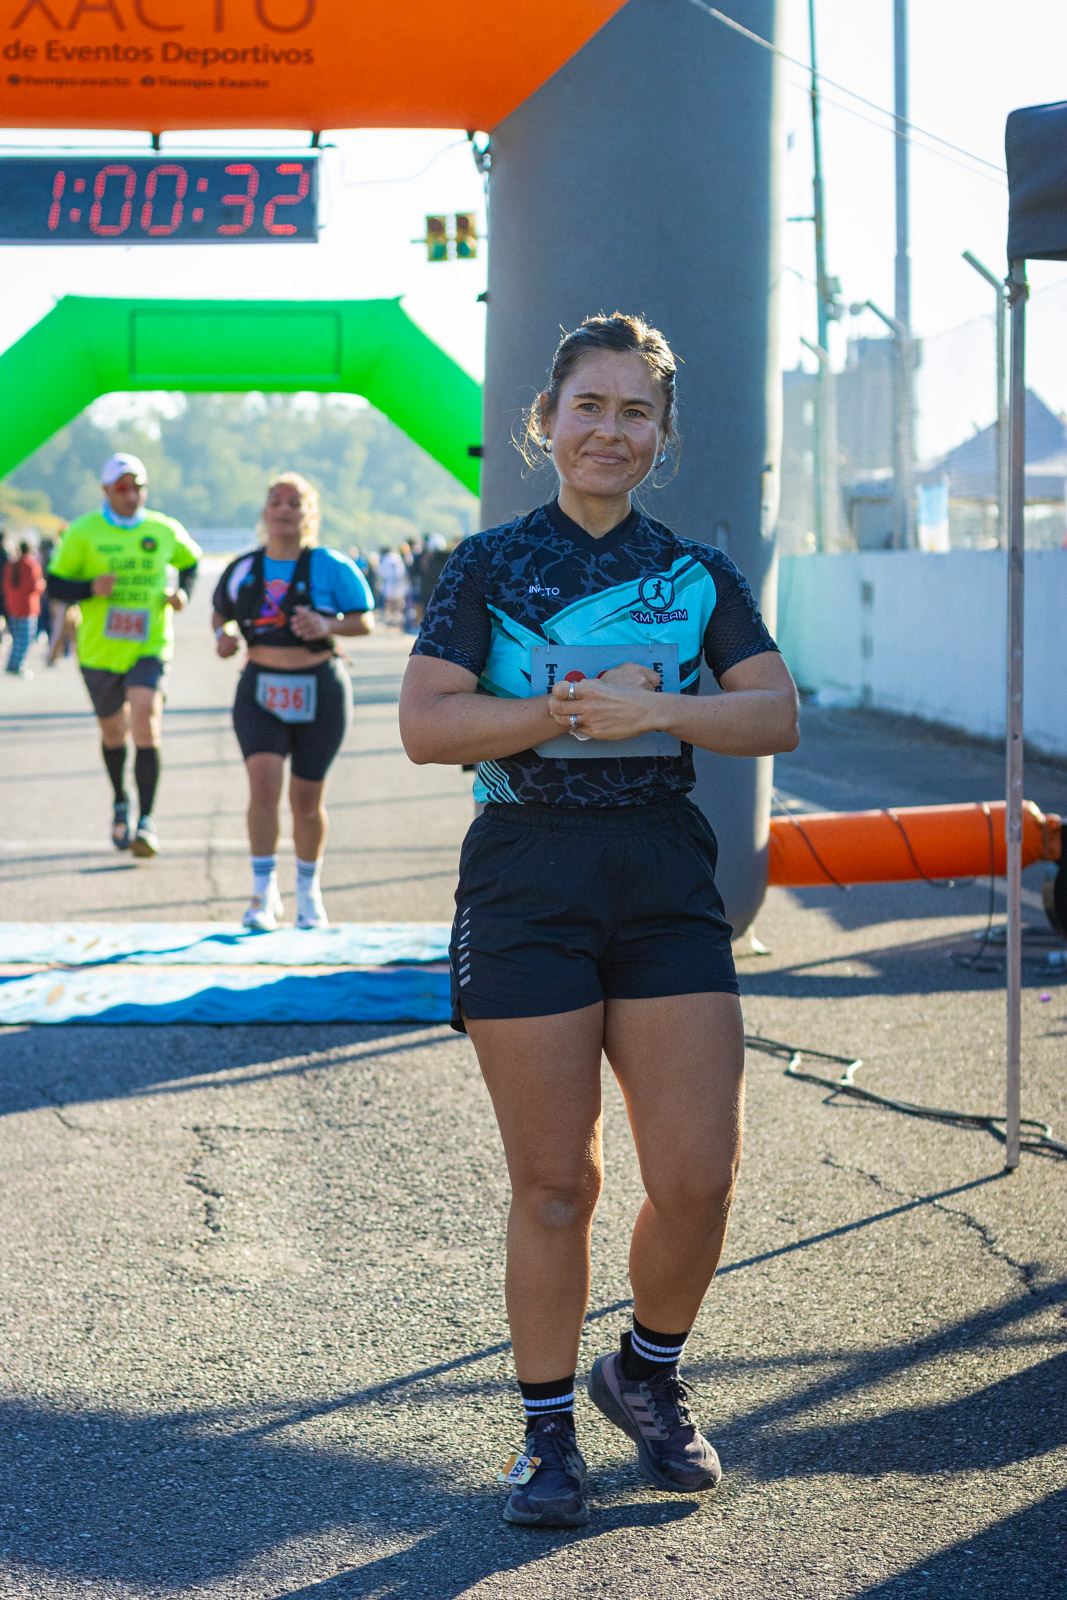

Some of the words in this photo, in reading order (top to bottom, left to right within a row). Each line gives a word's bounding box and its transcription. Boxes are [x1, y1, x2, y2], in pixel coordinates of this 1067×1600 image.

[3, 39, 38, 61] de
[45, 40, 154, 62] Eventos
[161, 41, 315, 68] Deportivos
[48, 164, 310, 236] 1:00:32
[654, 609, 688, 624] TEAM
[266, 685, 304, 711] 236
